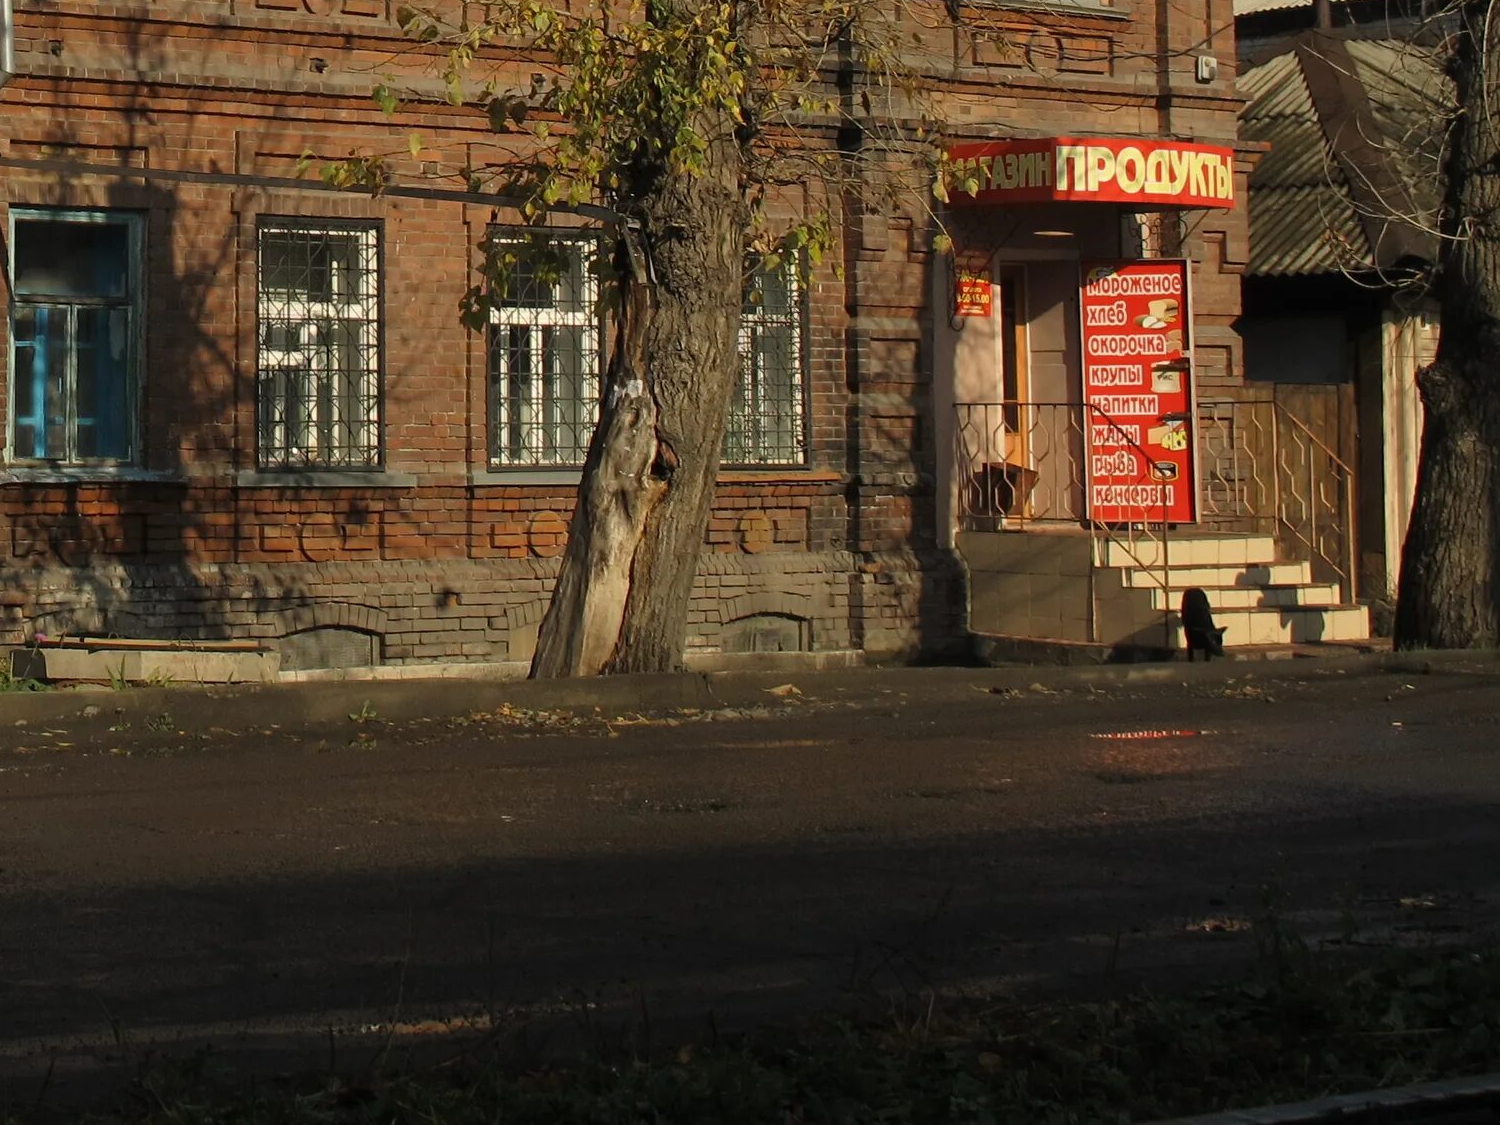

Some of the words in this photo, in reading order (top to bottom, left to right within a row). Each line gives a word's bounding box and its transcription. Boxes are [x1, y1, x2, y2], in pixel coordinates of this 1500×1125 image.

[1055, 145, 1234, 200] ПРОДУКТЫ
[1088, 302, 1126, 325] хлеб
[1089, 335, 1166, 355] окорочка
[1090, 366, 1142, 386] крупы
[1091, 395, 1158, 415] напитки
